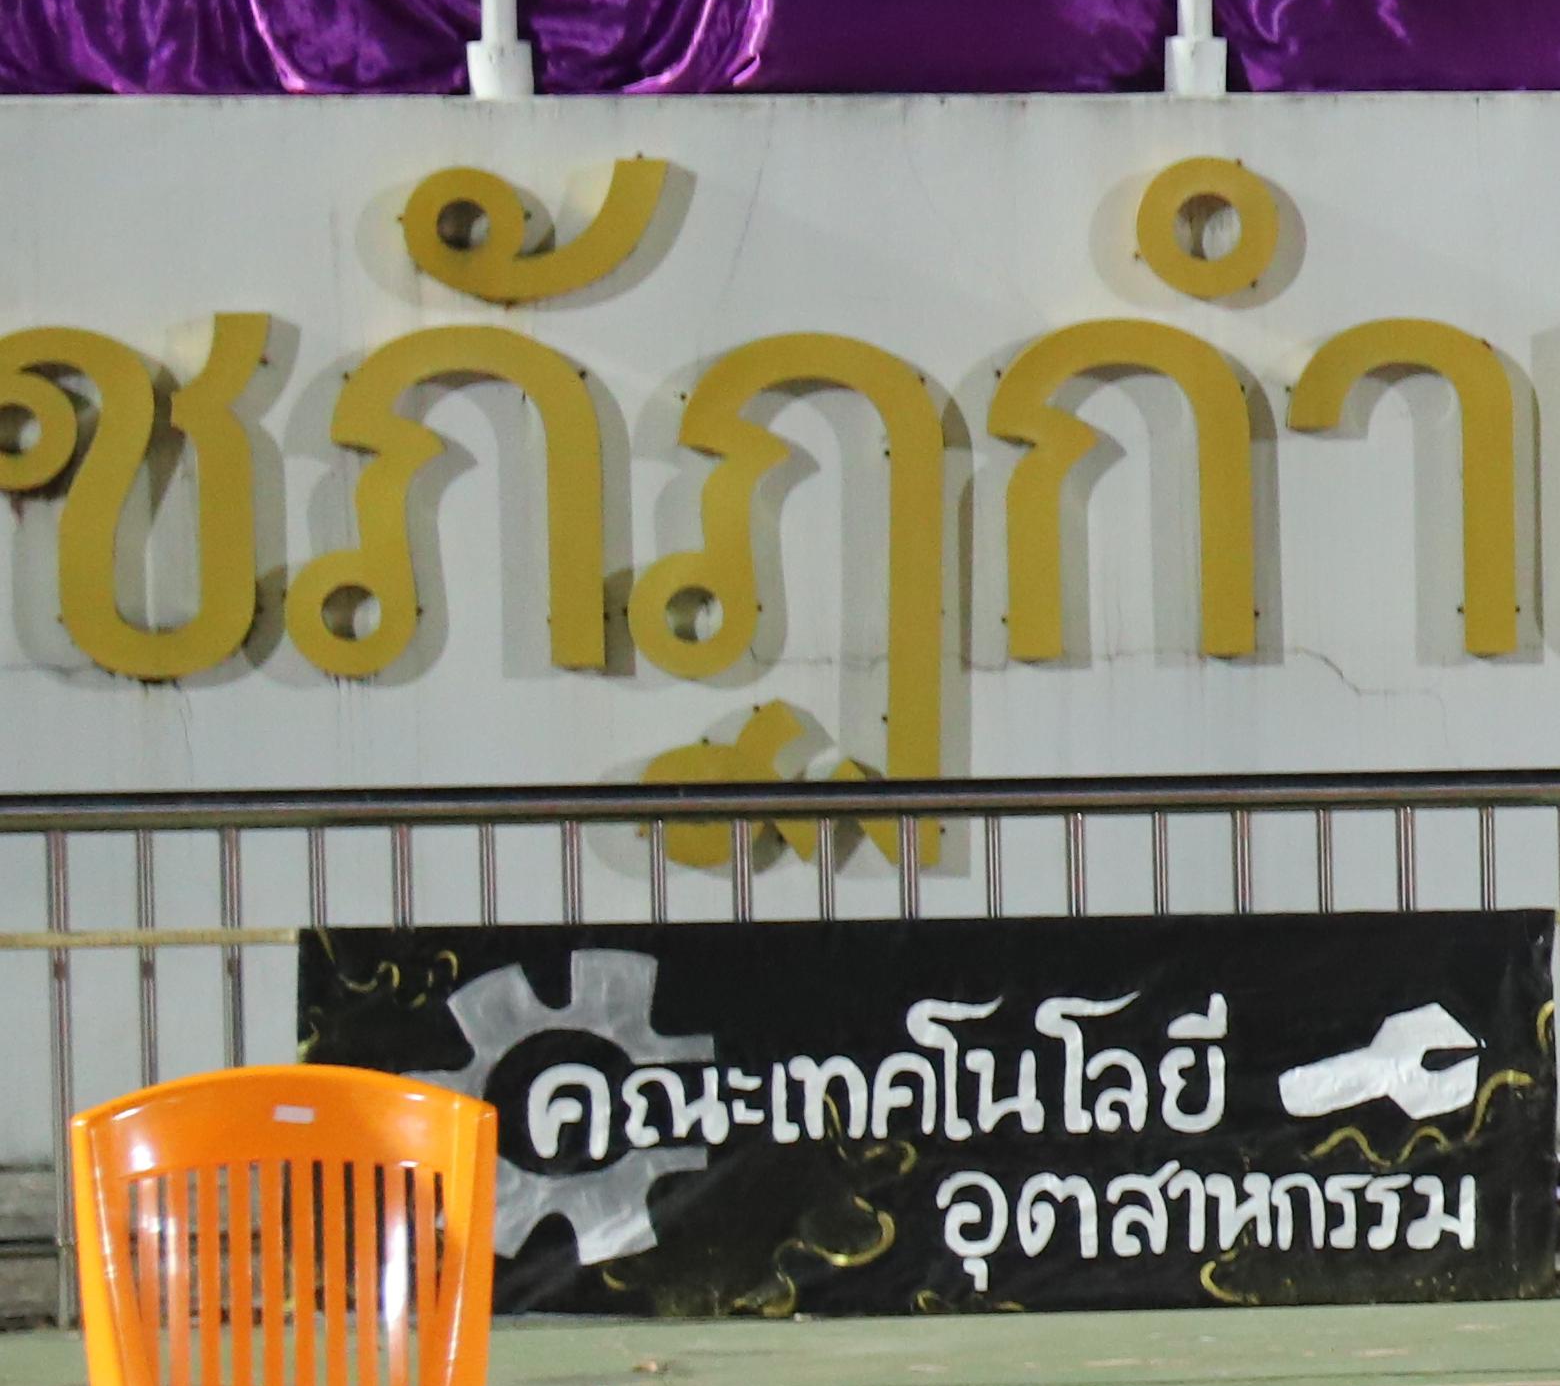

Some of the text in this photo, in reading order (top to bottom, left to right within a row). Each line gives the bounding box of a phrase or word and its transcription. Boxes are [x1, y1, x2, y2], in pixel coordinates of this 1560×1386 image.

[527, 990, 1229, 1160] คณะเทคโนโลยี
[936, 1159, 1477, 1293] อุตสาหกรรม
